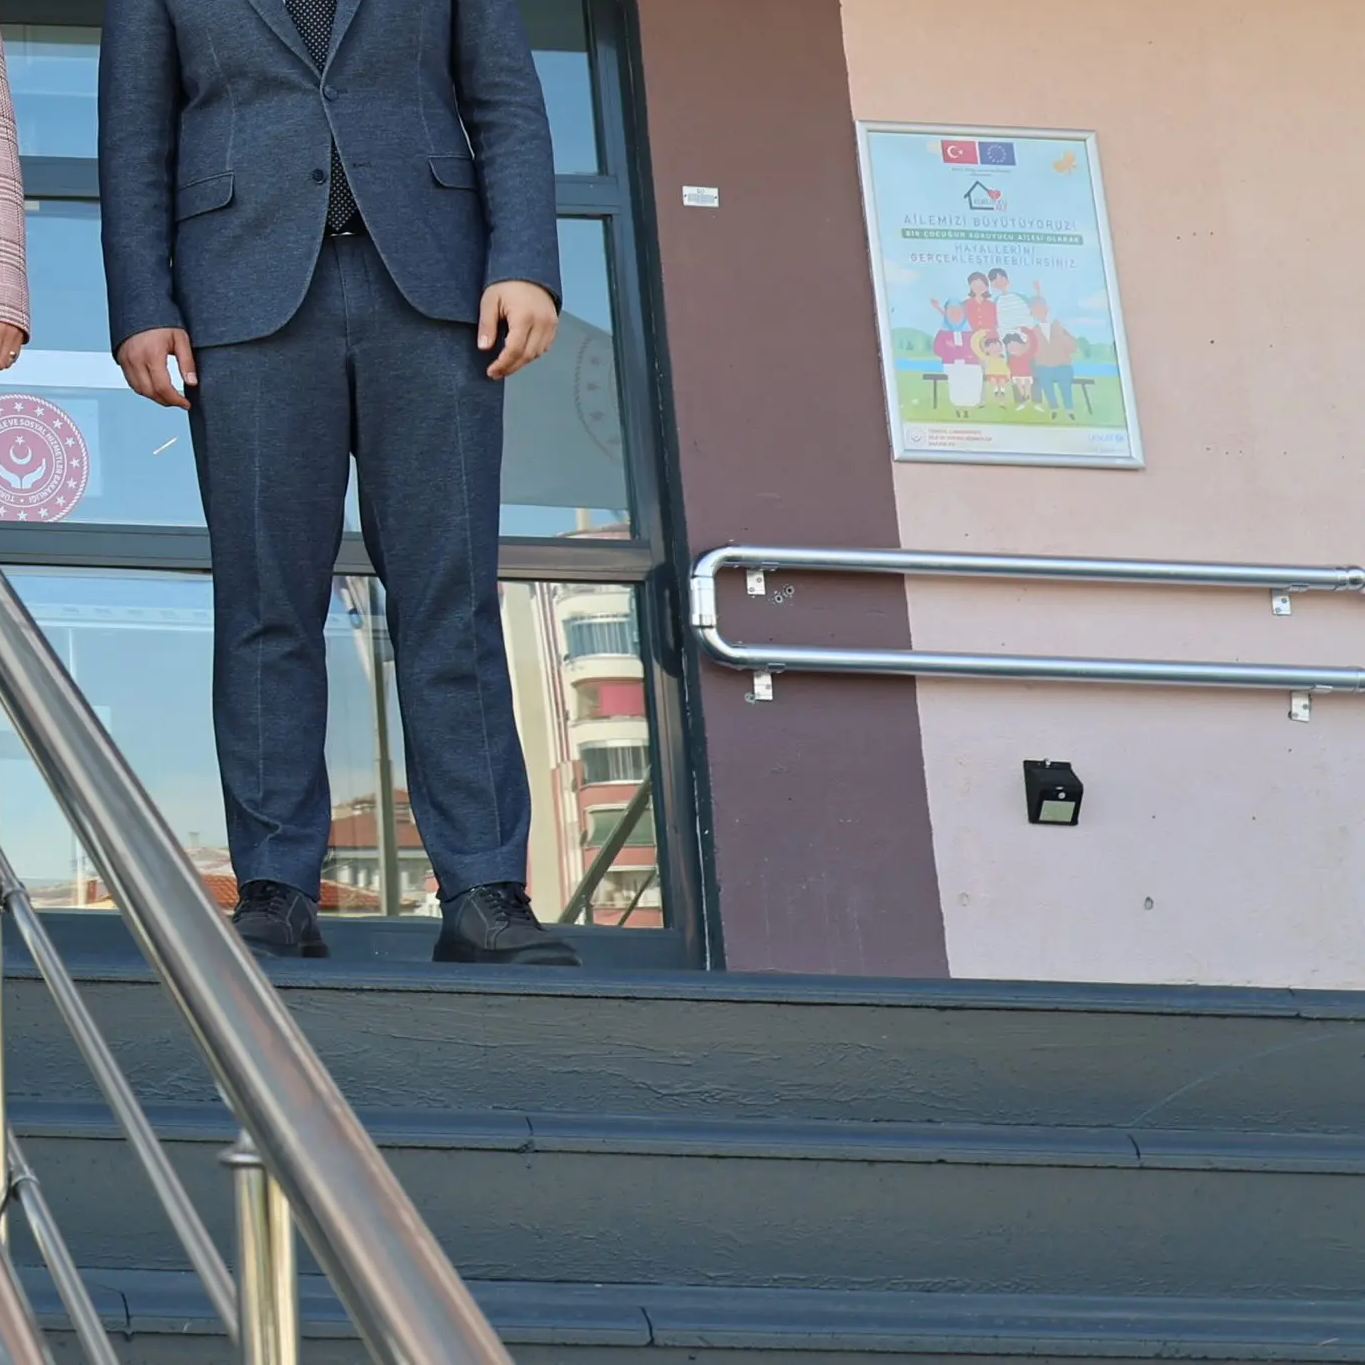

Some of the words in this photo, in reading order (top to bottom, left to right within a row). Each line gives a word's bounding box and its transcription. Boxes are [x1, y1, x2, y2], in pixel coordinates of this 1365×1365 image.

[904, 213, 967, 227] AİLEMİZİ
[8, 418, 18, 426] VE
[20, 418, 47, 435] SOSYAL
